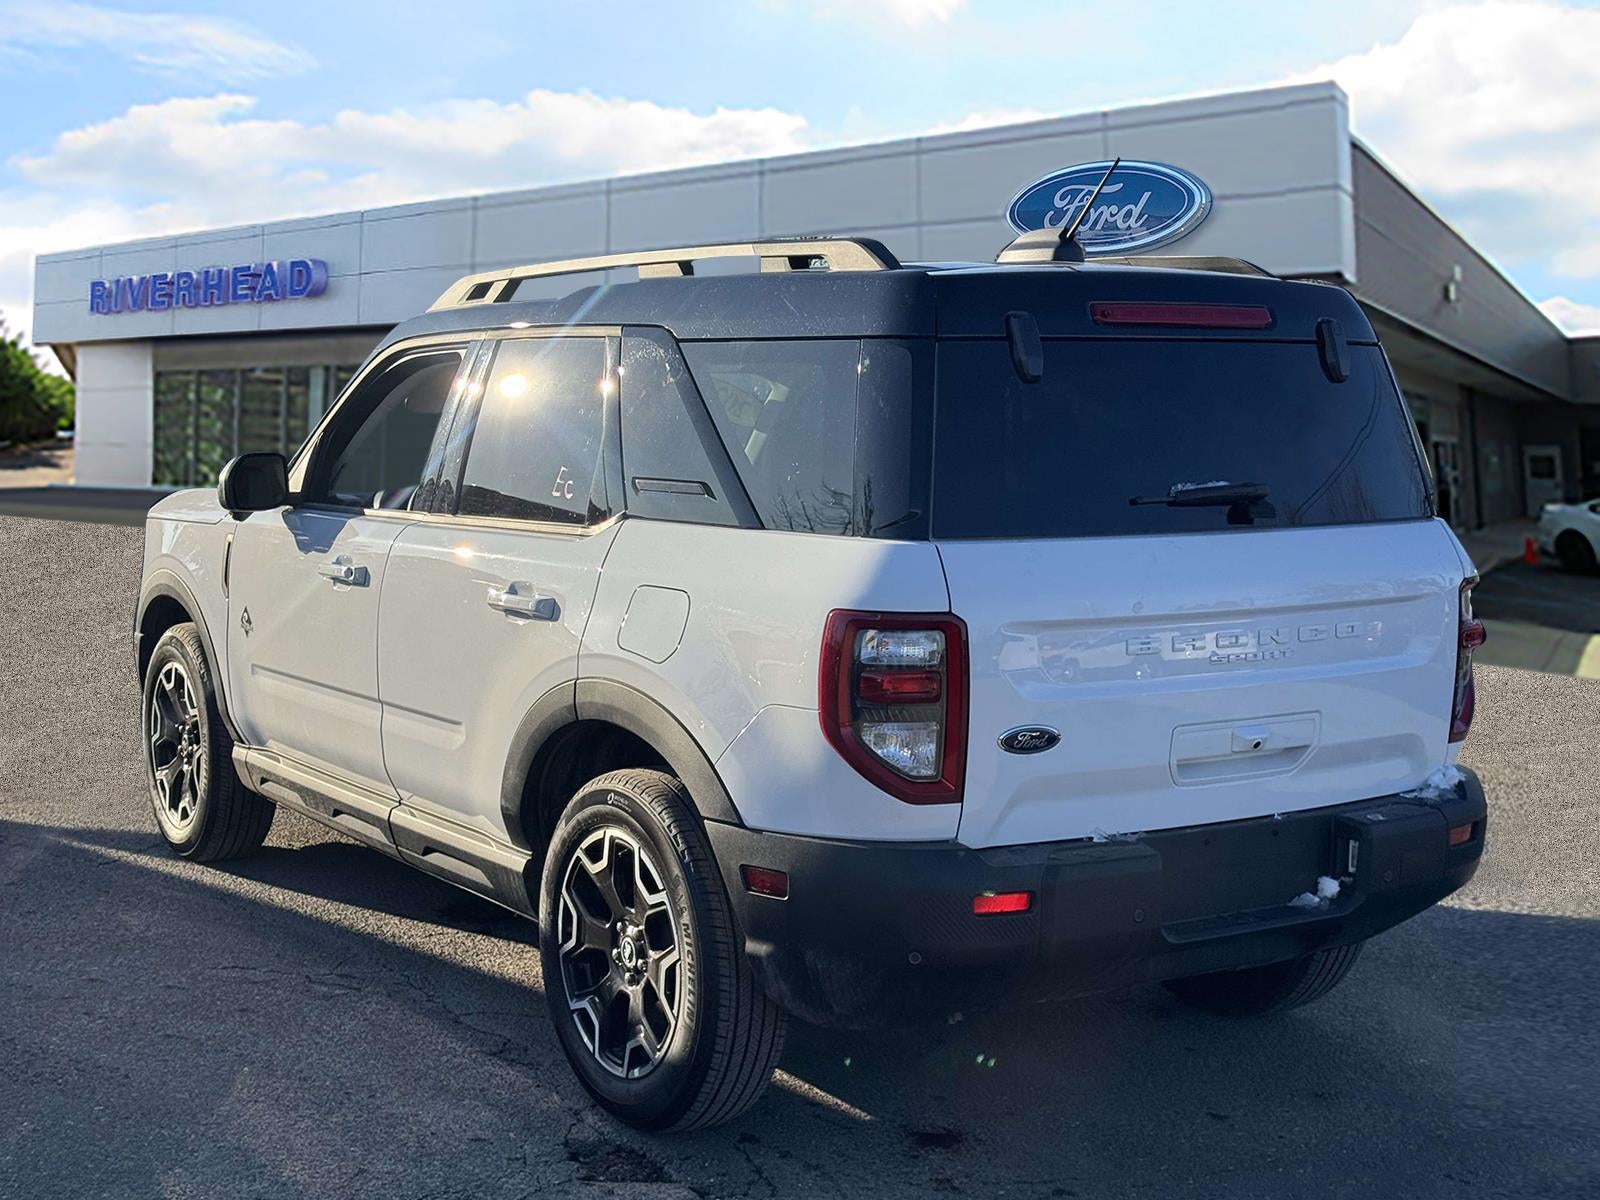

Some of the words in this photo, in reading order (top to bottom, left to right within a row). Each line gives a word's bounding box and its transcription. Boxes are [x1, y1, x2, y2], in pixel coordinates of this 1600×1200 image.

[1043, 182, 1152, 232] Ford
[89, 258, 327, 315] RIVERHEAD
[1125, 620, 1364, 657] BRONCO
[1208, 648, 1292, 665] SPORT
[1013, 731, 1049, 749] Ford
[682, 922, 696, 1025] MICHELIN
